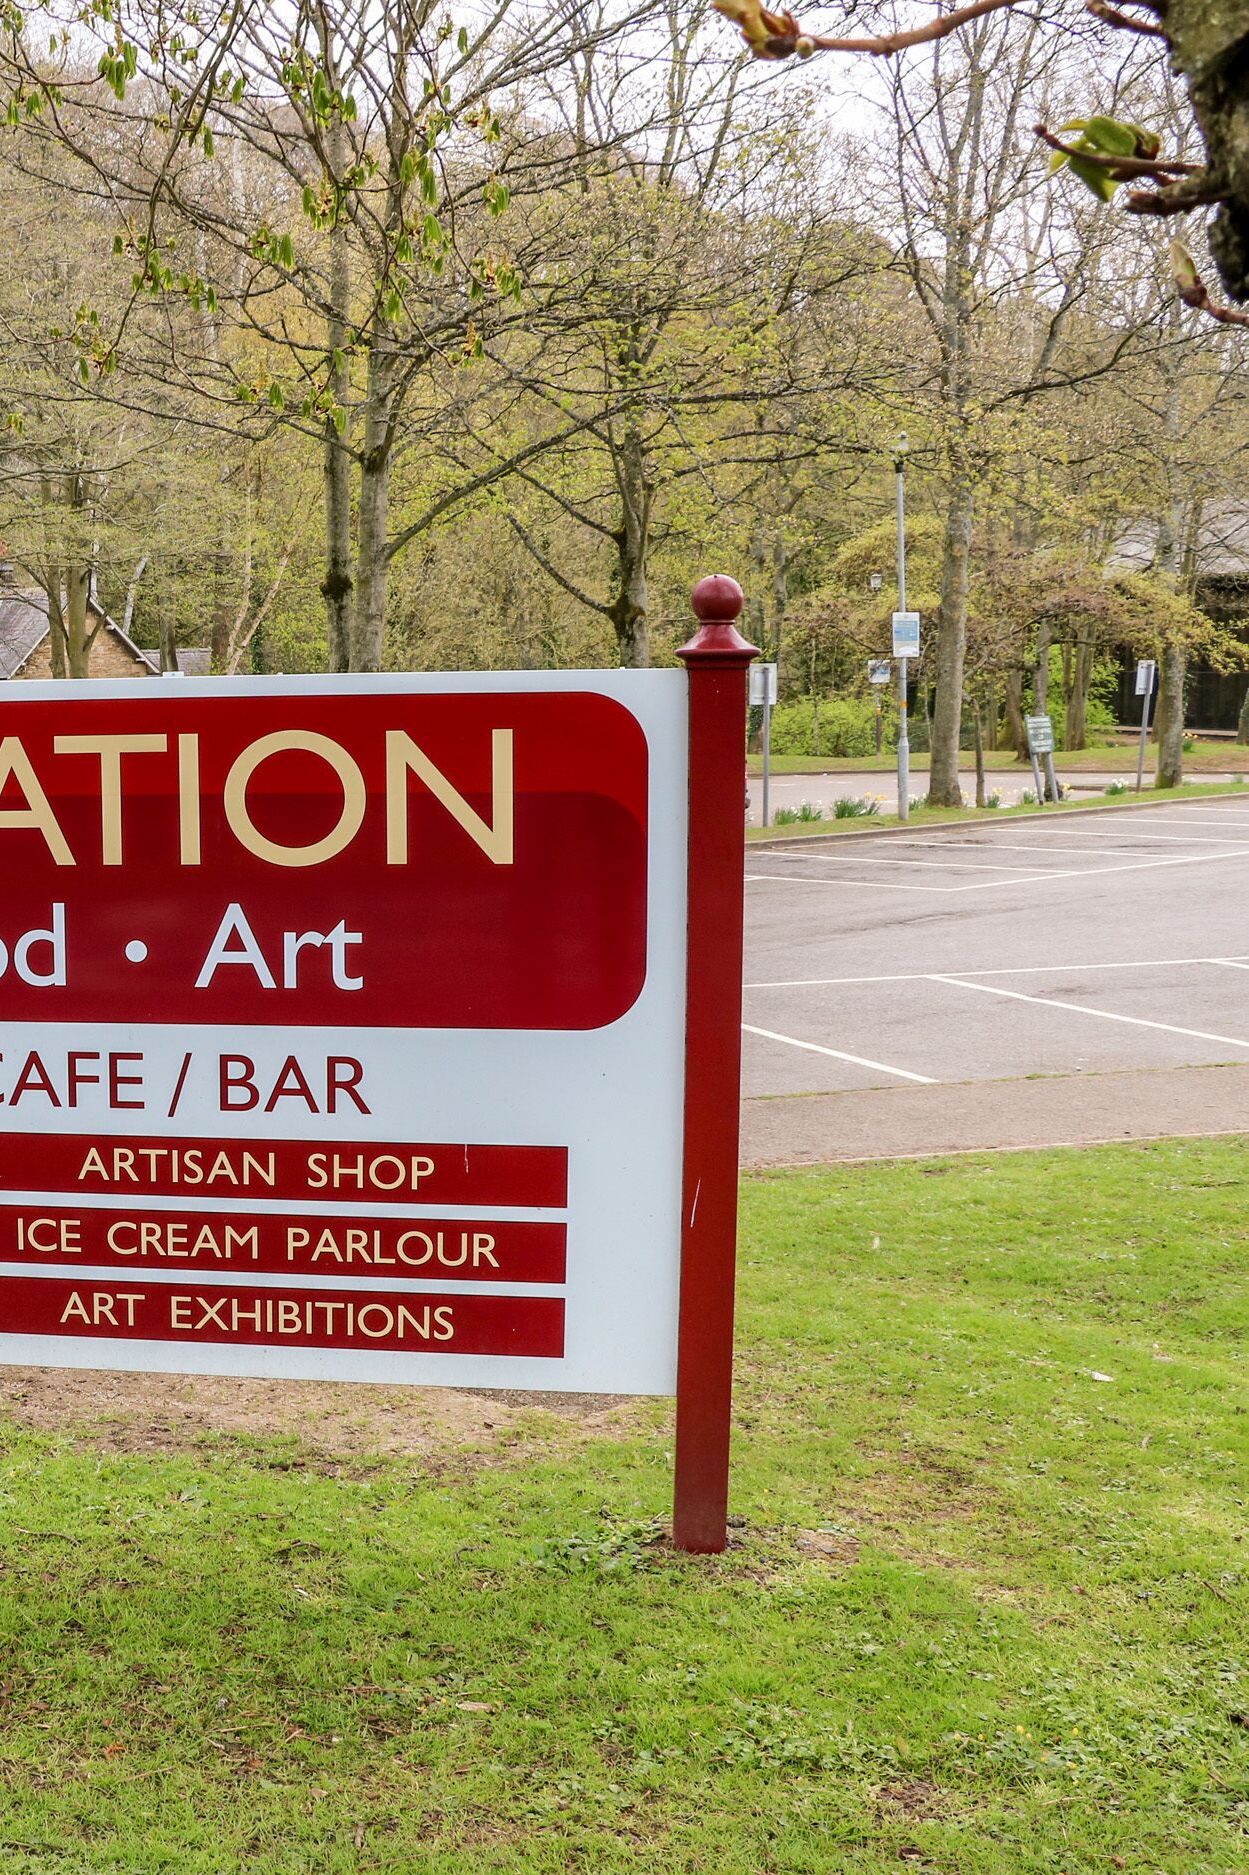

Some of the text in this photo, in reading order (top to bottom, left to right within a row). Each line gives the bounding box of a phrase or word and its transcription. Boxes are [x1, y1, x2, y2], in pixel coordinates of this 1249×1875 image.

[194, 902, 365, 991] Art
[219, 1054, 371, 1115] BAR
[78, 1146, 436, 1191] ARTISAN SHOP
[16, 1217, 500, 1269] ICE CREAM PARLOUR
[60, 1291, 455, 1341] ART EXHIBITIONS
